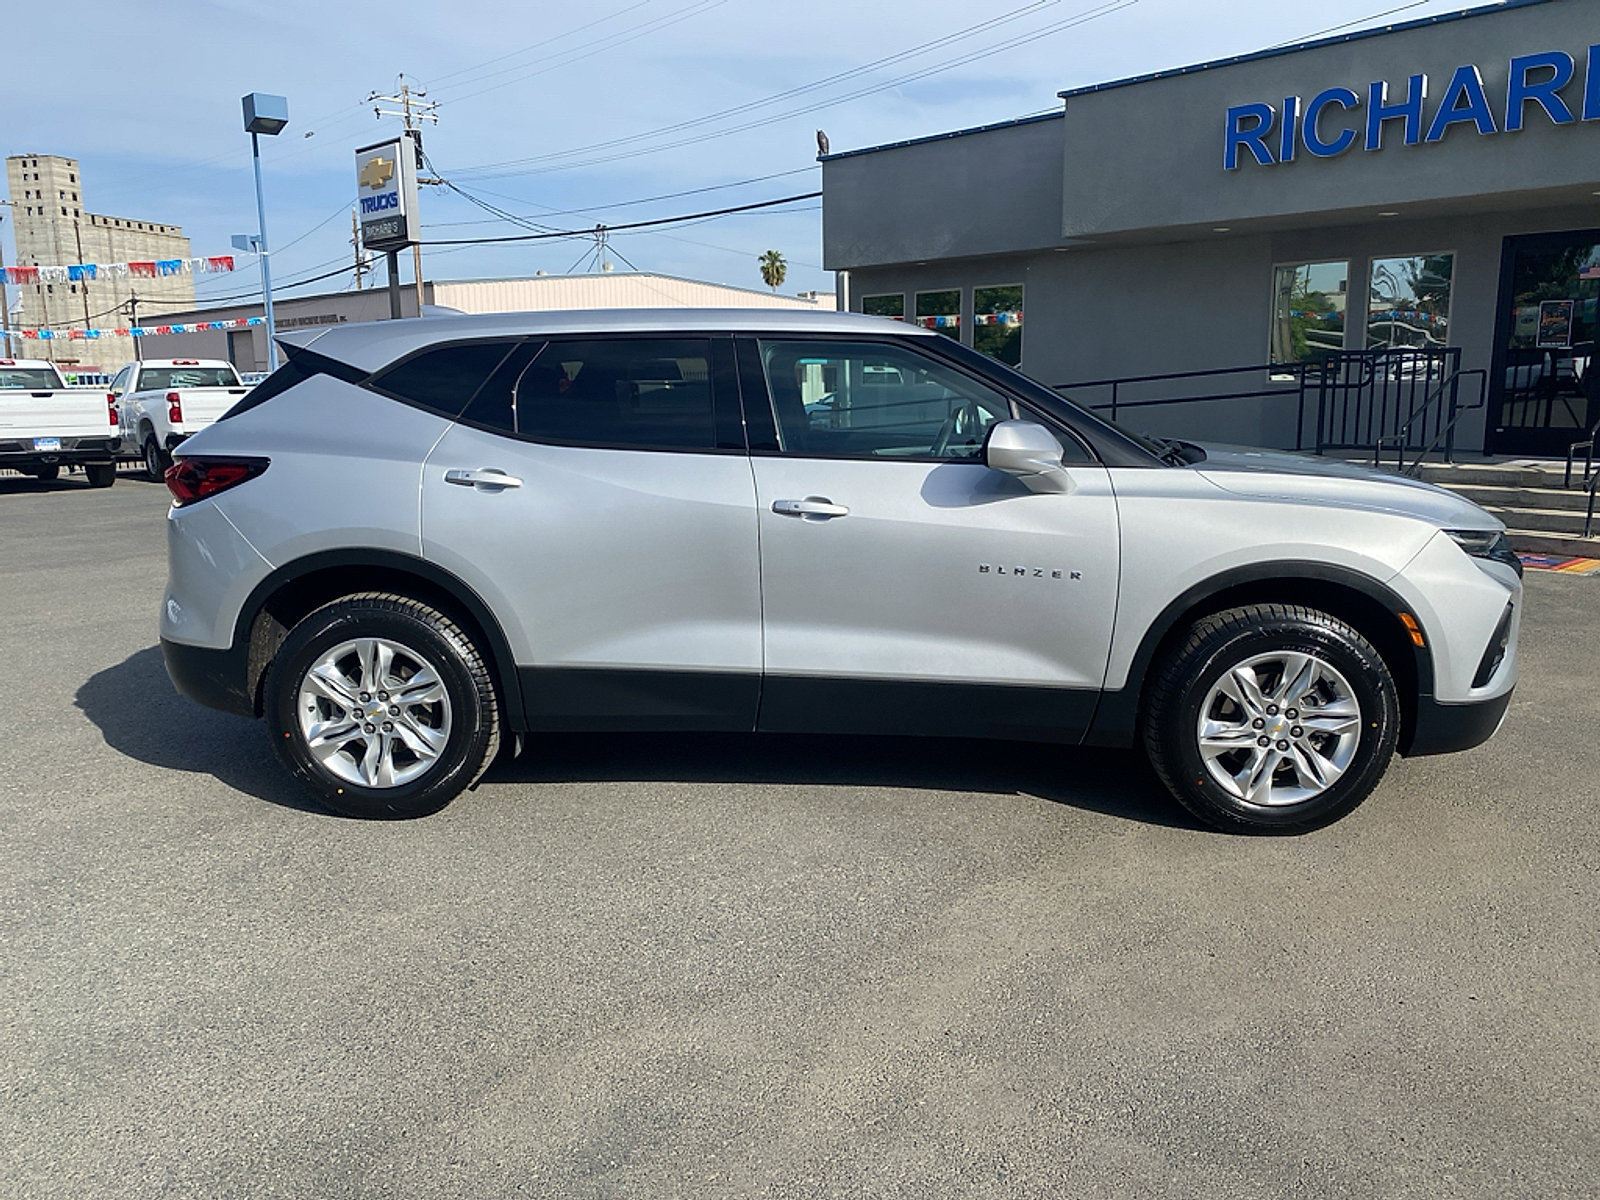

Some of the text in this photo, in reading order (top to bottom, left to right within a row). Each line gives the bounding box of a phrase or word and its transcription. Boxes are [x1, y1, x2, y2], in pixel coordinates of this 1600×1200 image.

[1223, 44, 1600, 170] RICHAR
[360, 192, 398, 213] TRUCKS
[979, 563, 1082, 581] BLAZER
